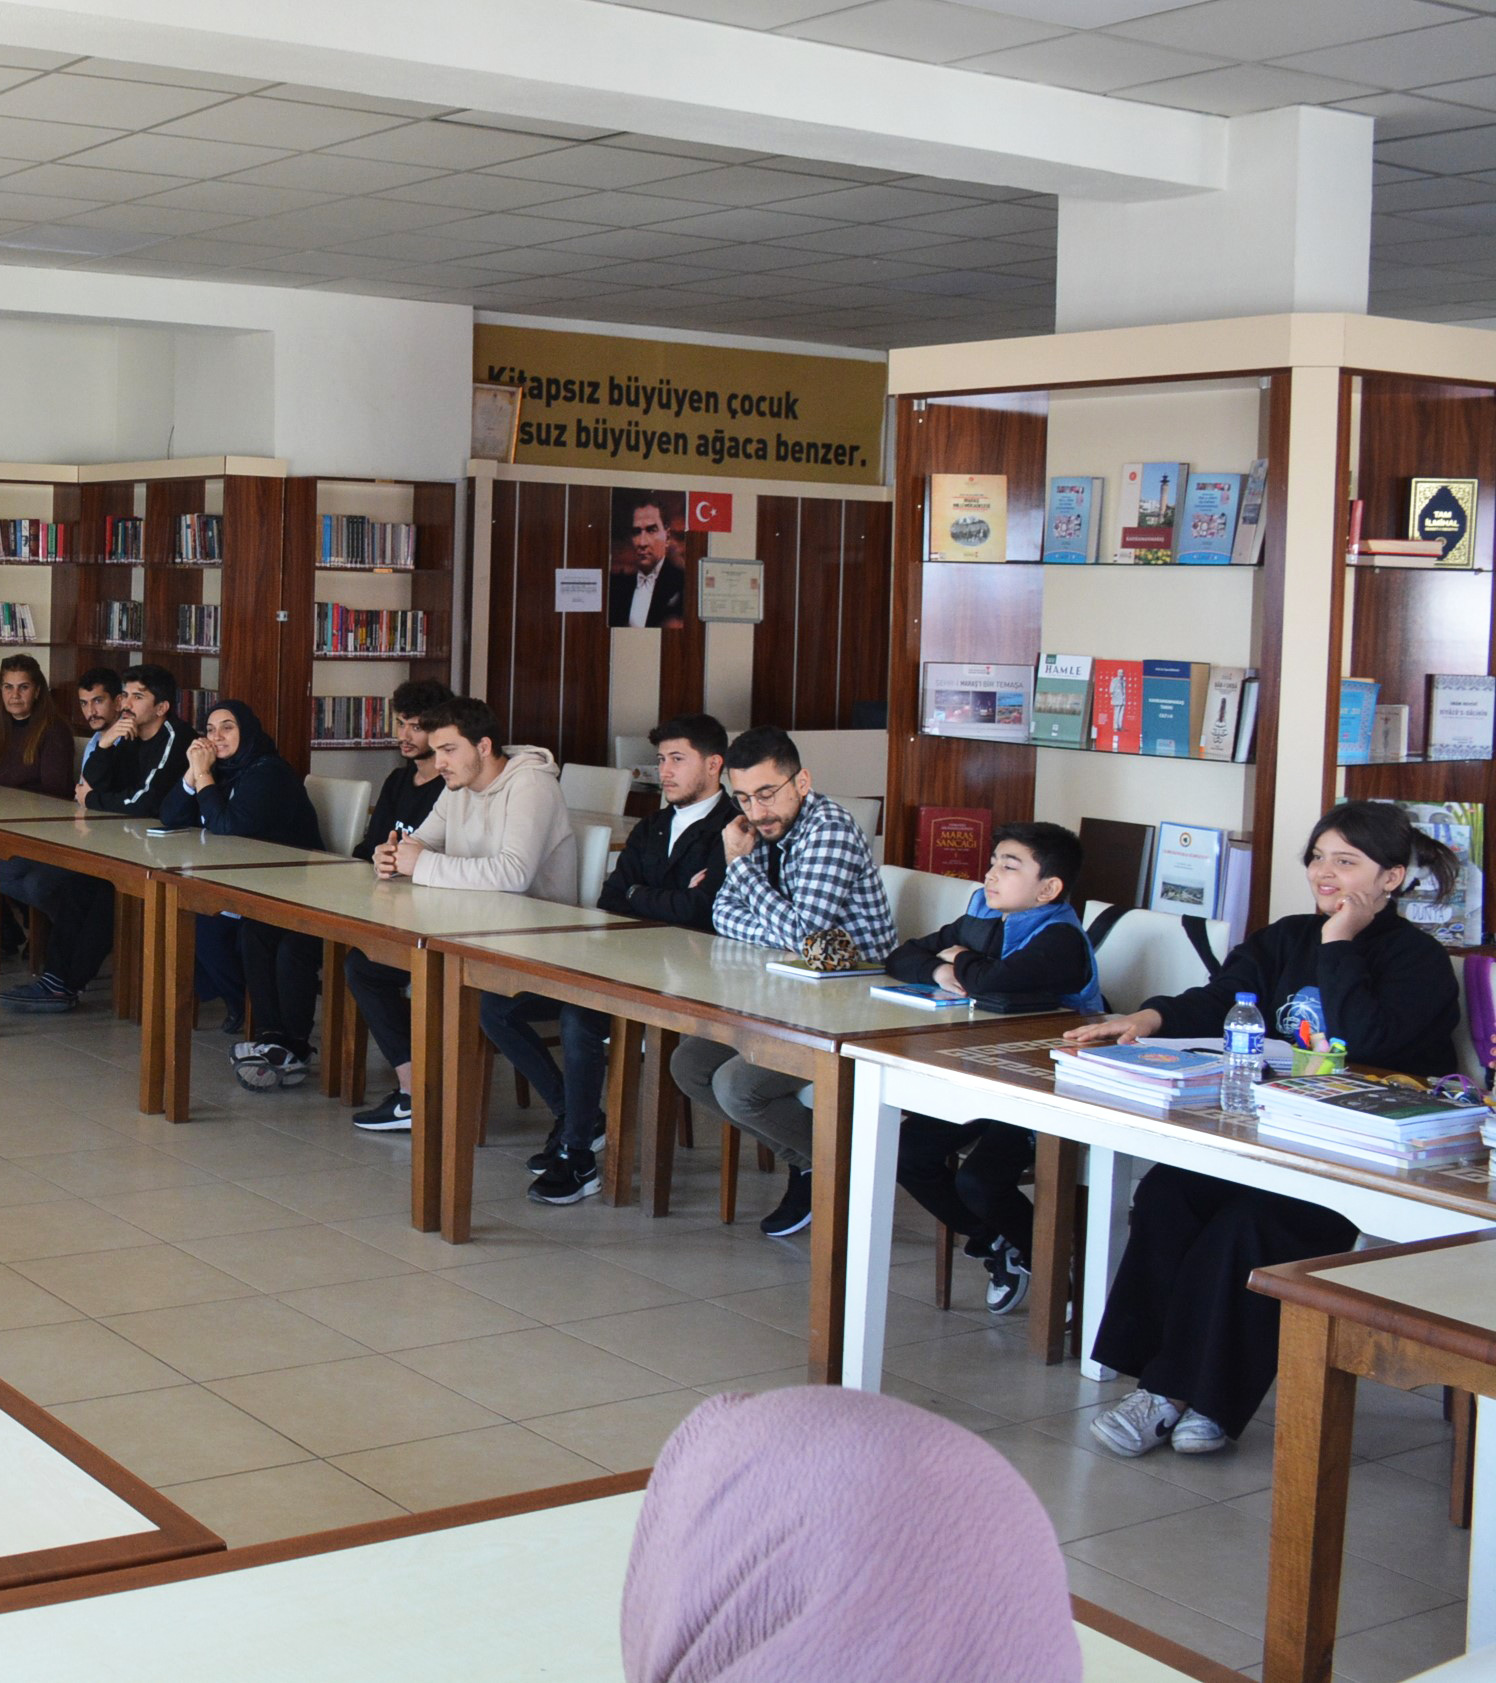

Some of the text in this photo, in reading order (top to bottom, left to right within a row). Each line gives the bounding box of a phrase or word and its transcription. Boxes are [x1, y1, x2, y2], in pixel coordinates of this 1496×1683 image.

[608, 375, 720, 417] büyüyen
[726, 391, 800, 421] çocuk
[518, 420, 567, 448] suz
[575, 418, 689, 460] büyüyen
[695, 428, 768, 465] ağaca
[775, 434, 867, 468] benzer.
[1433, 510, 1452, 518] TAM
[1045, 664, 1082, 676] HAMLE
